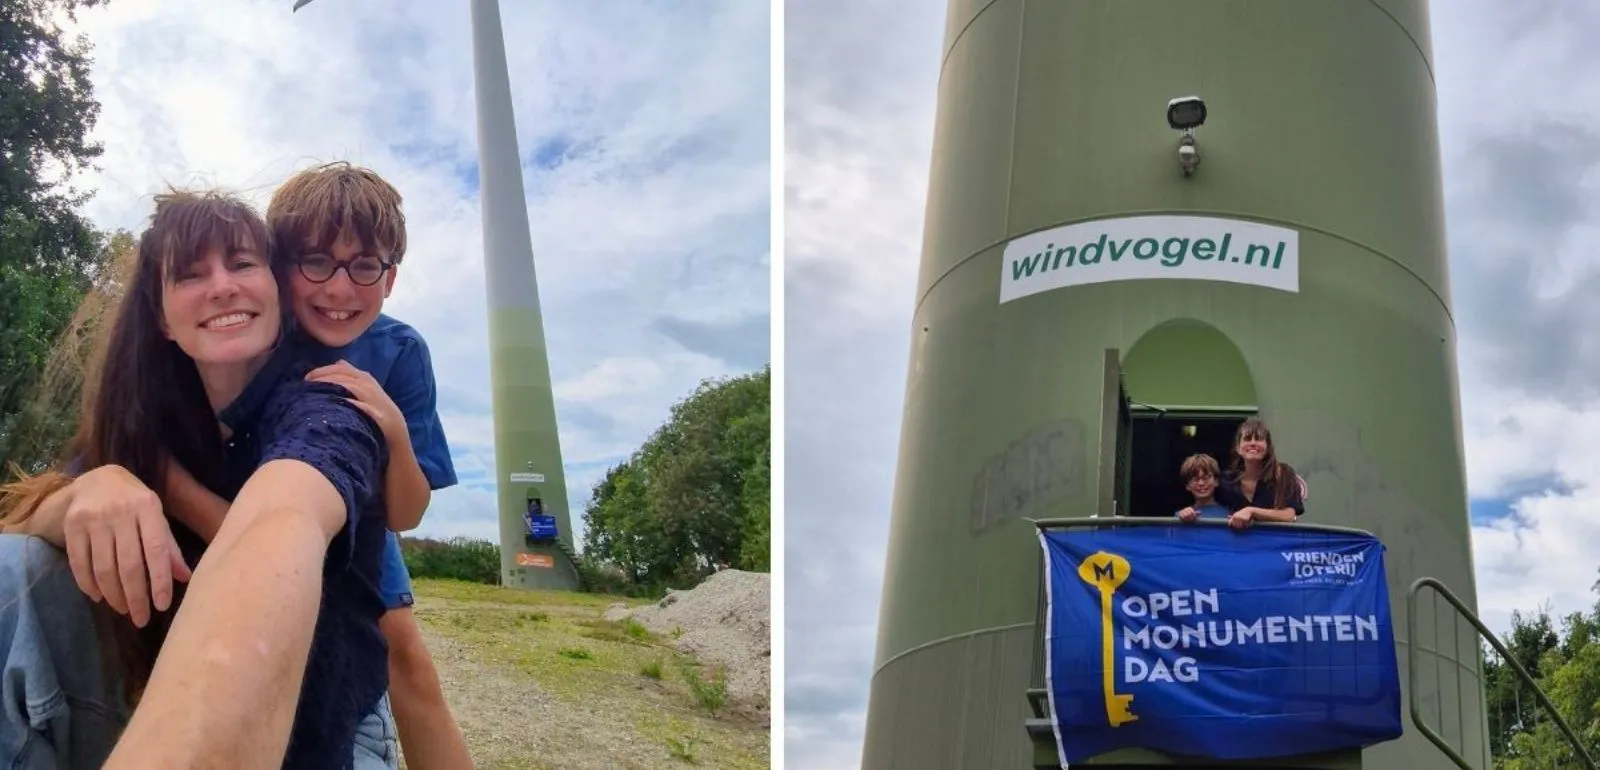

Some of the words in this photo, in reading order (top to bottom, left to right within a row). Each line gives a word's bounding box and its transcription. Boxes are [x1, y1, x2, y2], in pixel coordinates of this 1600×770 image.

[1011, 233, 1287, 281] windvogel.nl
[1092, 560, 1115, 582] M
[1281, 551, 1364, 565] VRIENDEN
[1294, 562, 1356, 578] LOTERIJ
[1121, 588, 1219, 620] OPEN
[1123, 614, 1379, 651] MONUMENTEN
[1124, 656, 1200, 684] DAG
